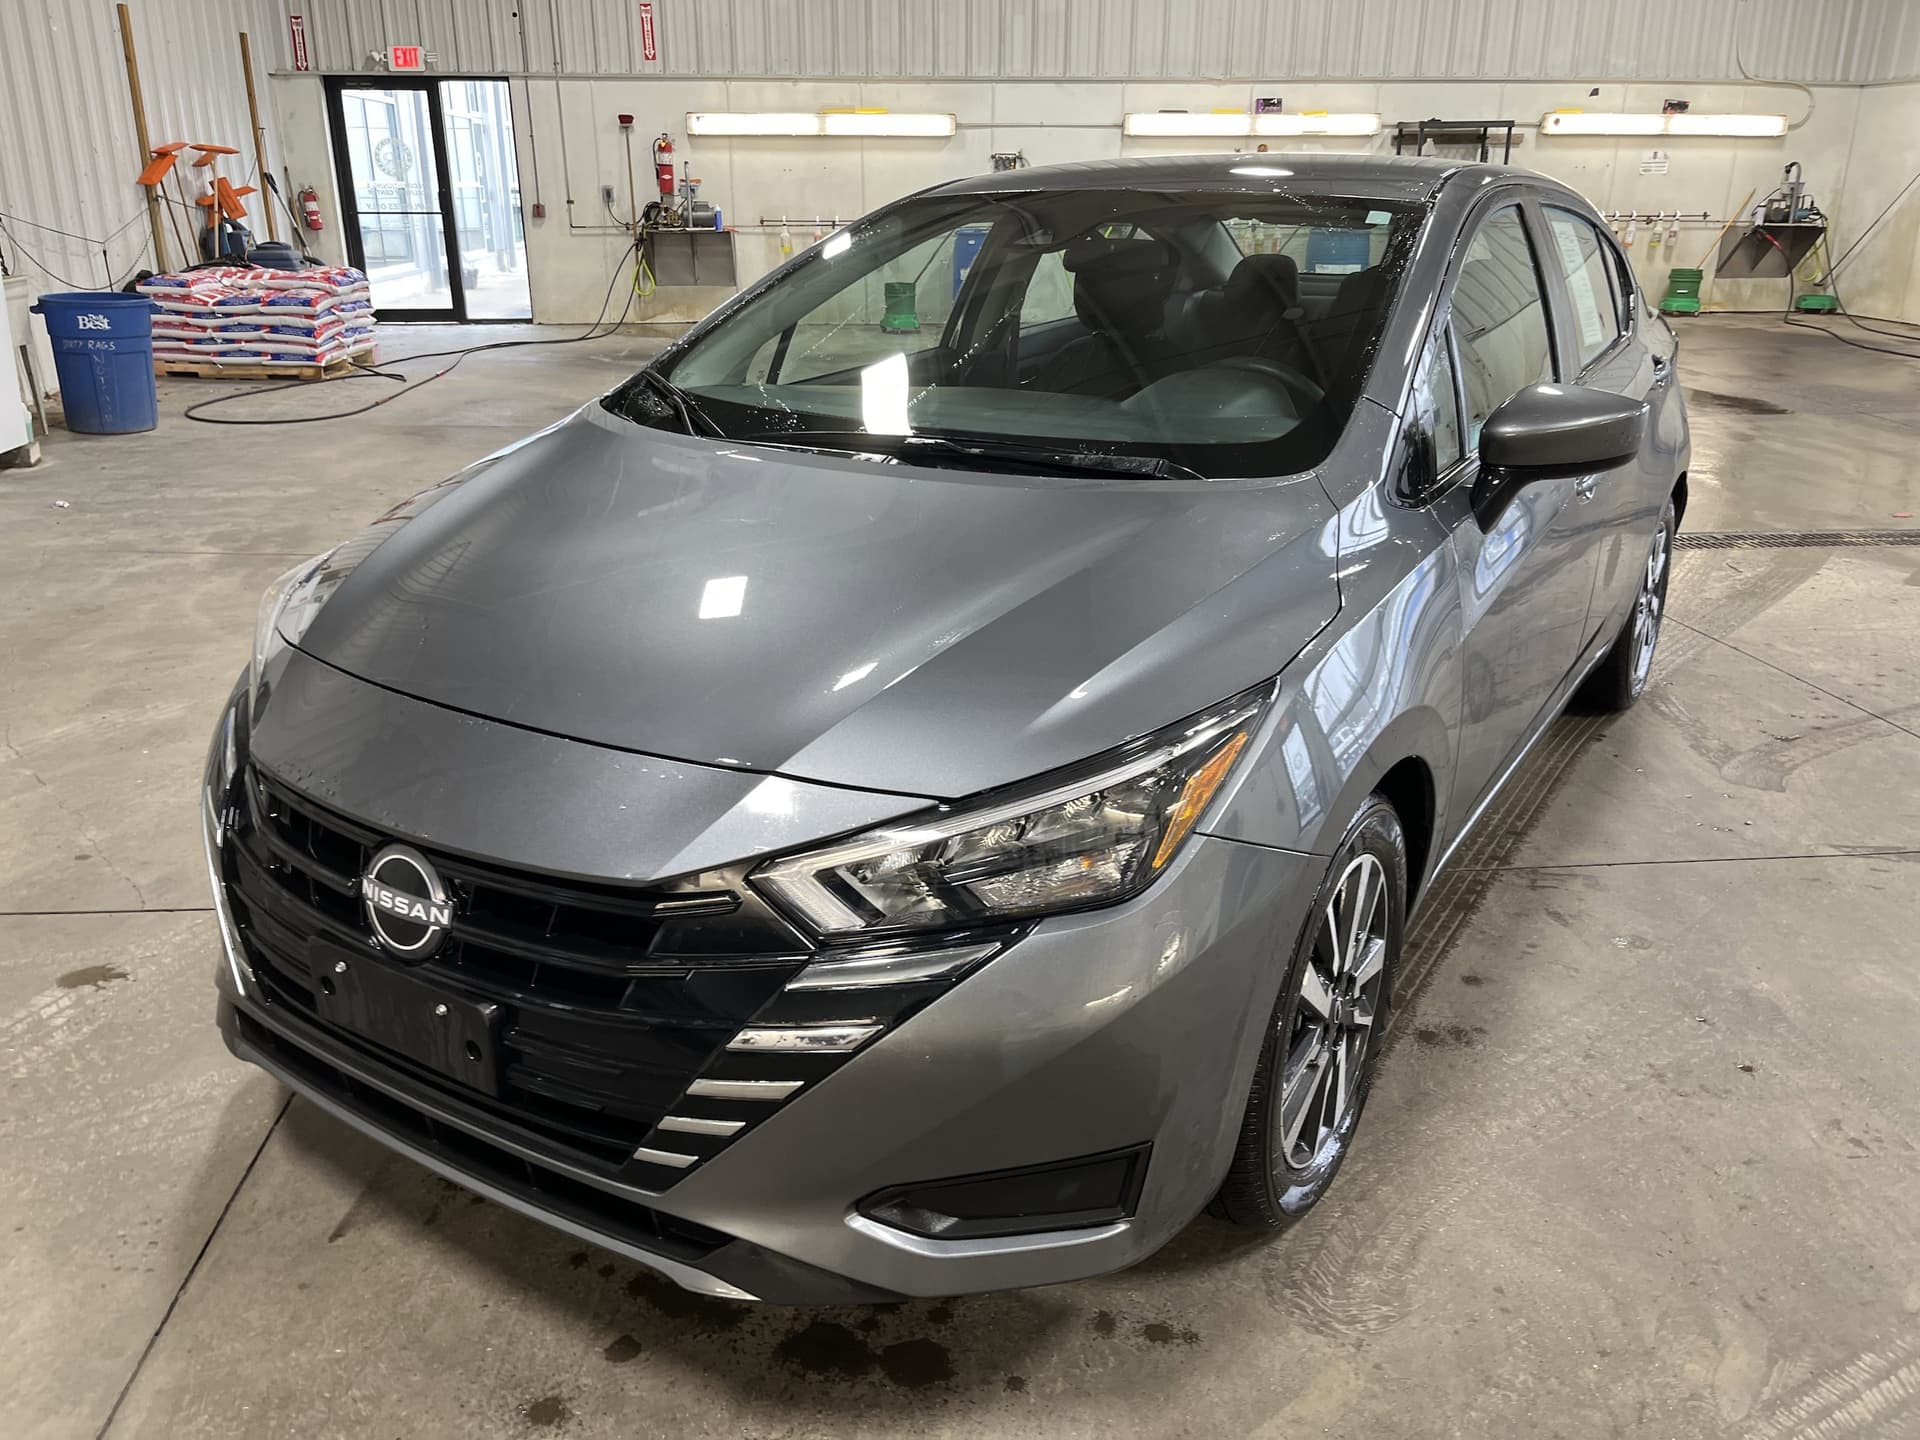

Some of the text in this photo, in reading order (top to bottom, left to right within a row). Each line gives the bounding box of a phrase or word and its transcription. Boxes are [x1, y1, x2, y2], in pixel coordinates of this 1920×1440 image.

[393, 47, 418, 67] EXIT
[76, 315, 112, 330] Best
[87, 340, 116, 351] RAGS
[362, 879, 449, 925] NISSAN
